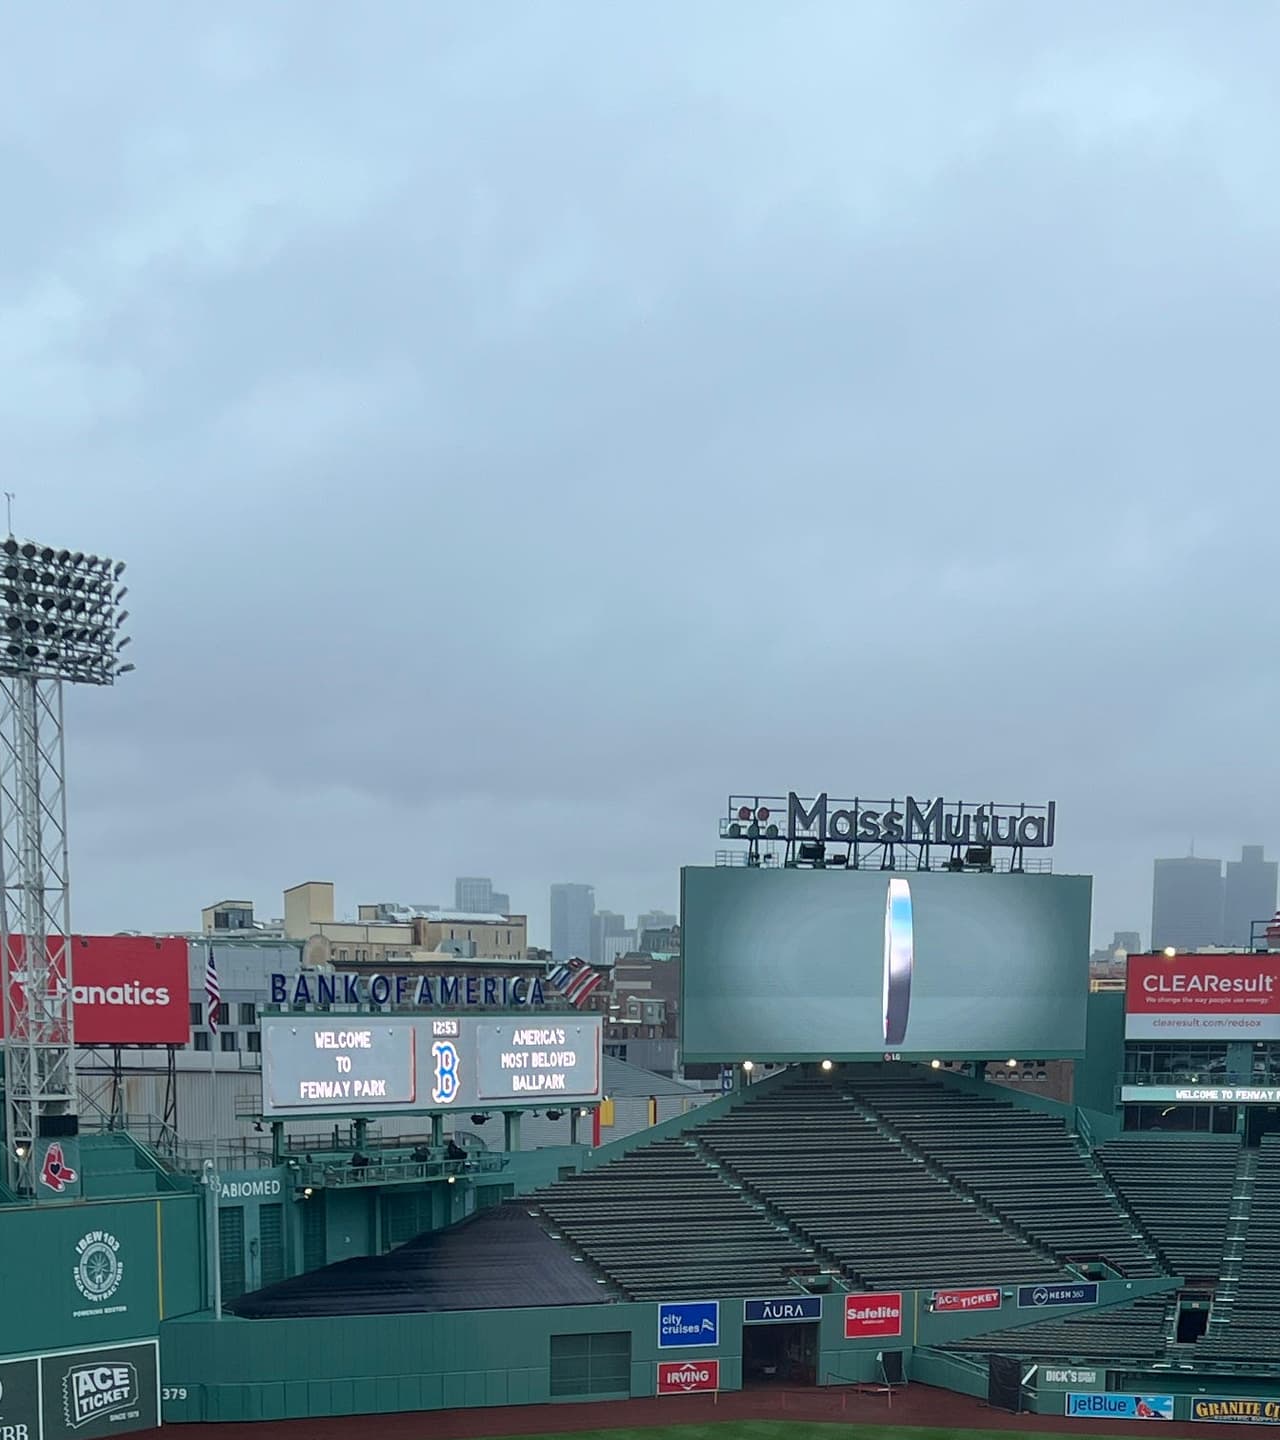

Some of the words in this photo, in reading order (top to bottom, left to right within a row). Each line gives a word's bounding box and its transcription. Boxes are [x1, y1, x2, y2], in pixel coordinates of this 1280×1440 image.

[787, 791, 1056, 848] MassMutual
[271, 973, 361, 1005] BANK
[371, 974, 409, 1004] OF
[415, 975, 546, 1005] AMERICA
[1143, 974, 1274, 993] CLEAResult
[432, 1021, 458, 1036] 12:53
[1152, 1017, 1261, 1029] clearesult.com/redsox
[315, 1032, 371, 1049] WELCOME
[512, 1029, 566, 1046] AMERICA'S
[336, 1056, 351, 1073] TO
[501, 1053, 528, 1069] MOST
[531, 1051, 576, 1068] BELOVED
[300, 1080, 350, 1099] FENWAY
[354, 1079, 386, 1097] PARK
[512, 1074, 566, 1091] BALLPARK
[1176, 1090, 1218, 1099] WELCOME
[1236, 1090, 1273, 1100] FENWAY
[221, 1179, 281, 1199] ABIOMED
[960, 1292, 999, 1308] TICKET
[663, 1314, 682, 1327] city
[847, 1307, 900, 1320] Safelite
[662, 1324, 700, 1335] cruises
[78, 1367, 130, 1397] ACE
[667, 1370, 709, 1384] IRVING
[1046, 1369, 1077, 1382] DICK'S
[79, 1386, 130, 1413] TICKET
[162, 1388, 187, 1400] 379
[1072, 1395, 1127, 1414] jetBlue
[1195, 1401, 1261, 1417] GRANITE
